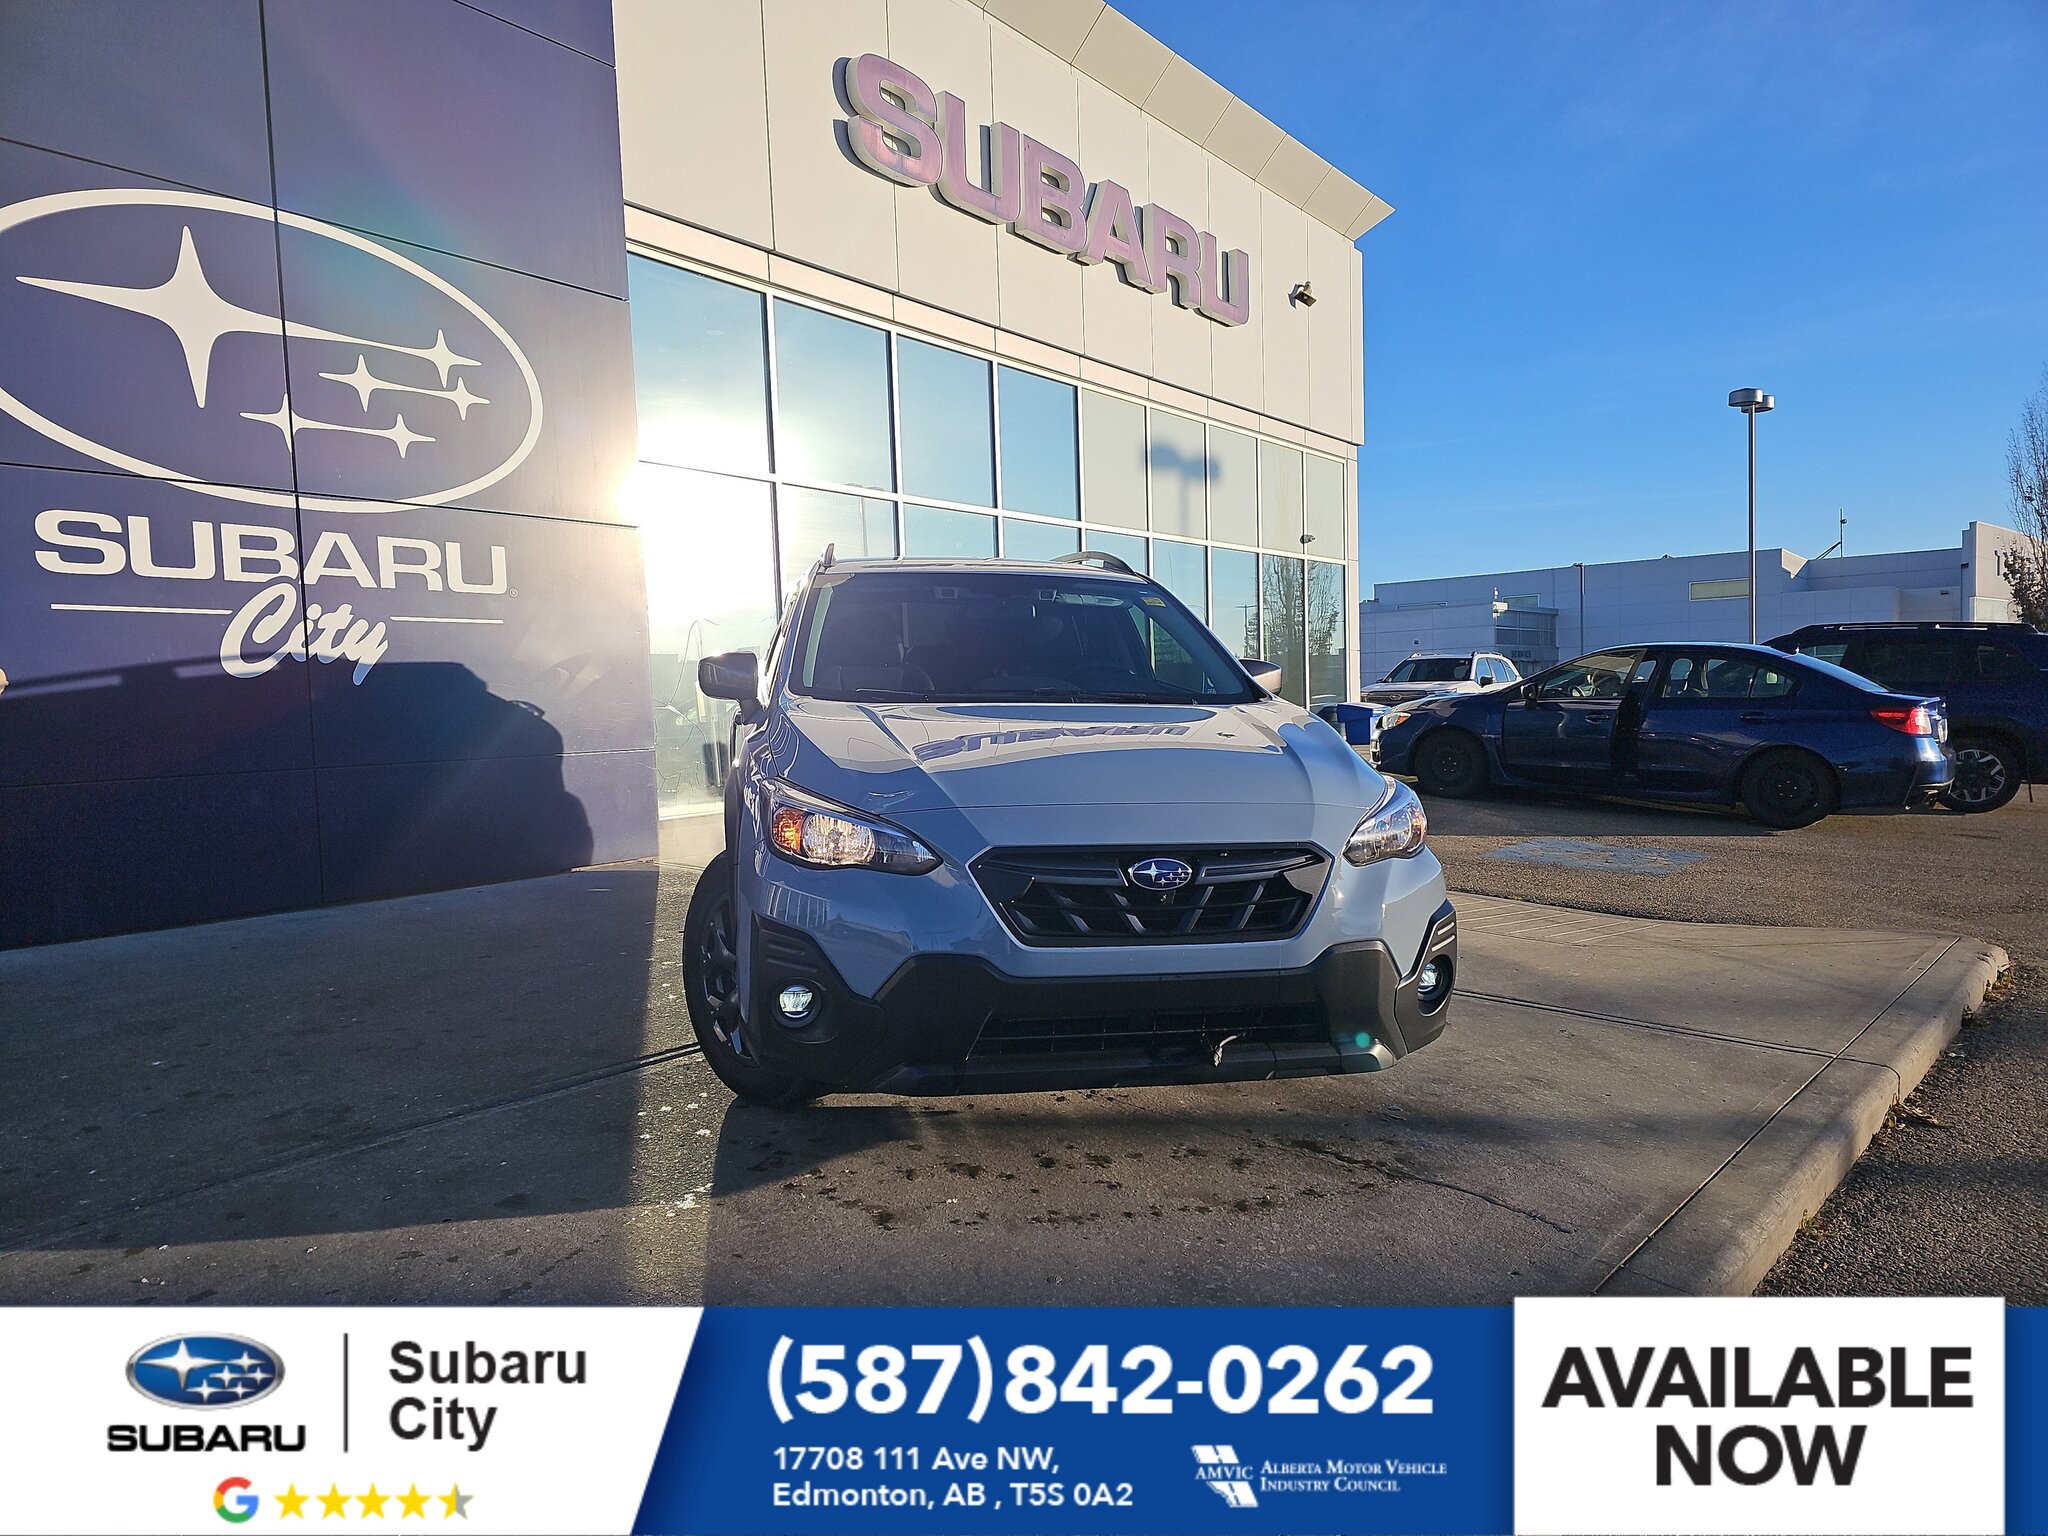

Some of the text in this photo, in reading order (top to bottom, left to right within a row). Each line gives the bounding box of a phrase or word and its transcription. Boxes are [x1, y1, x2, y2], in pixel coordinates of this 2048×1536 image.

[833, 53, 1249, 327] SUBARU
[34, 510, 507, 595] SUBARU
[220, 584, 389, 686] City
